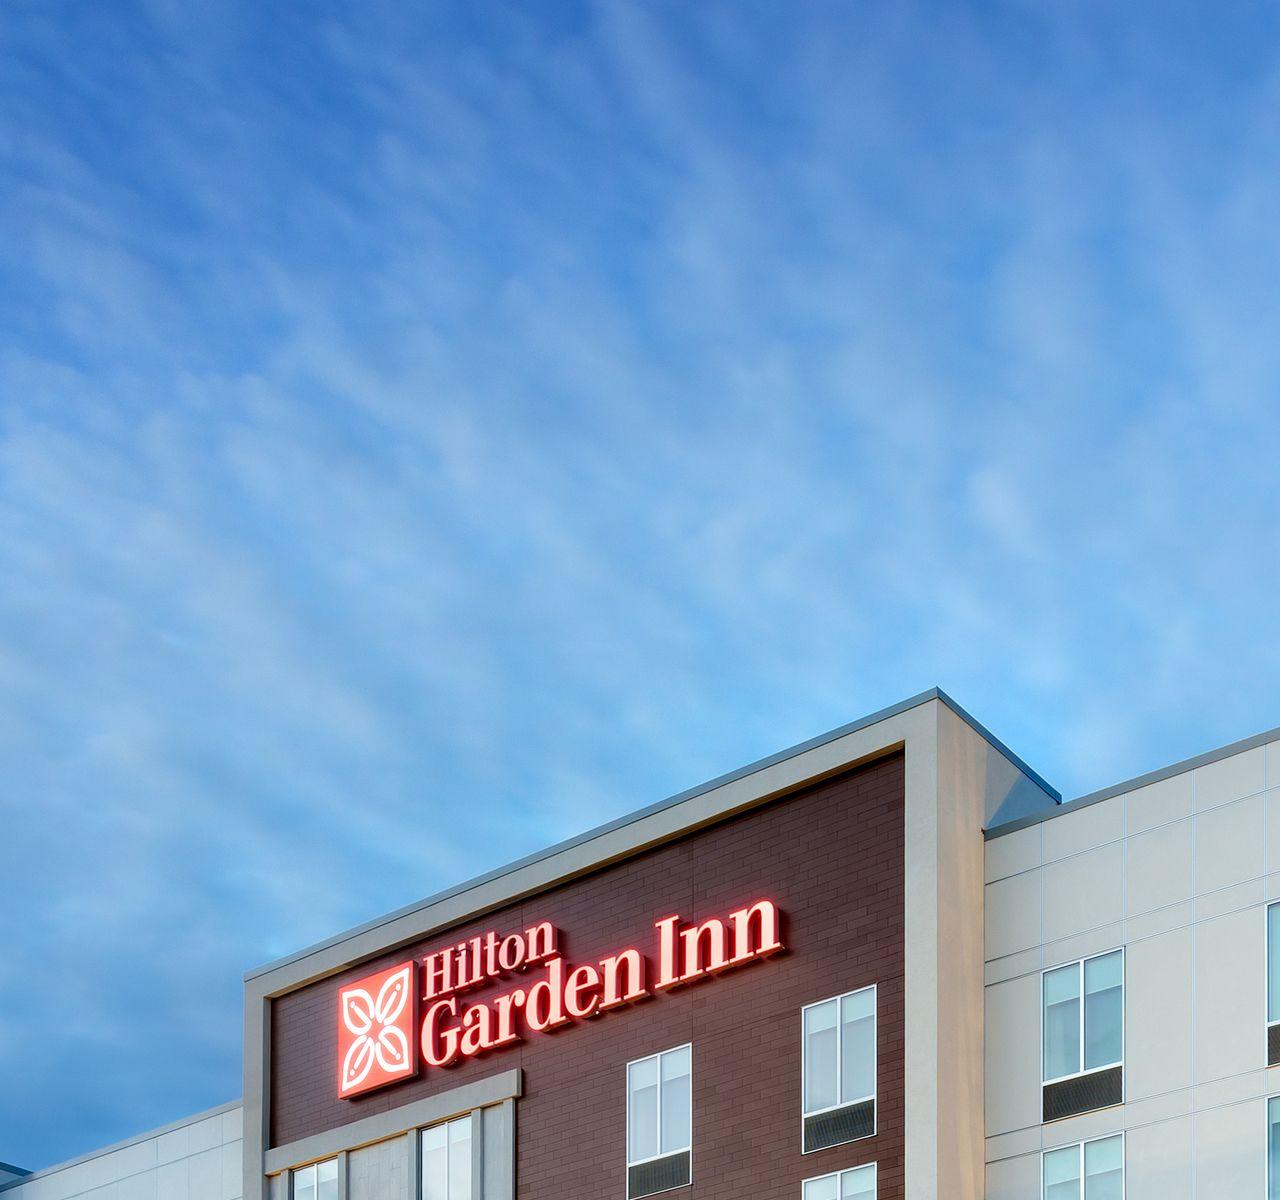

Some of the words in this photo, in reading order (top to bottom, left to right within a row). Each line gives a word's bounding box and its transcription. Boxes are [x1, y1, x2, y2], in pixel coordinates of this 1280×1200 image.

[420, 947, 648, 1068] Garden
[654, 898, 783, 990] Inn
[422, 921, 559, 1001] Hilton
